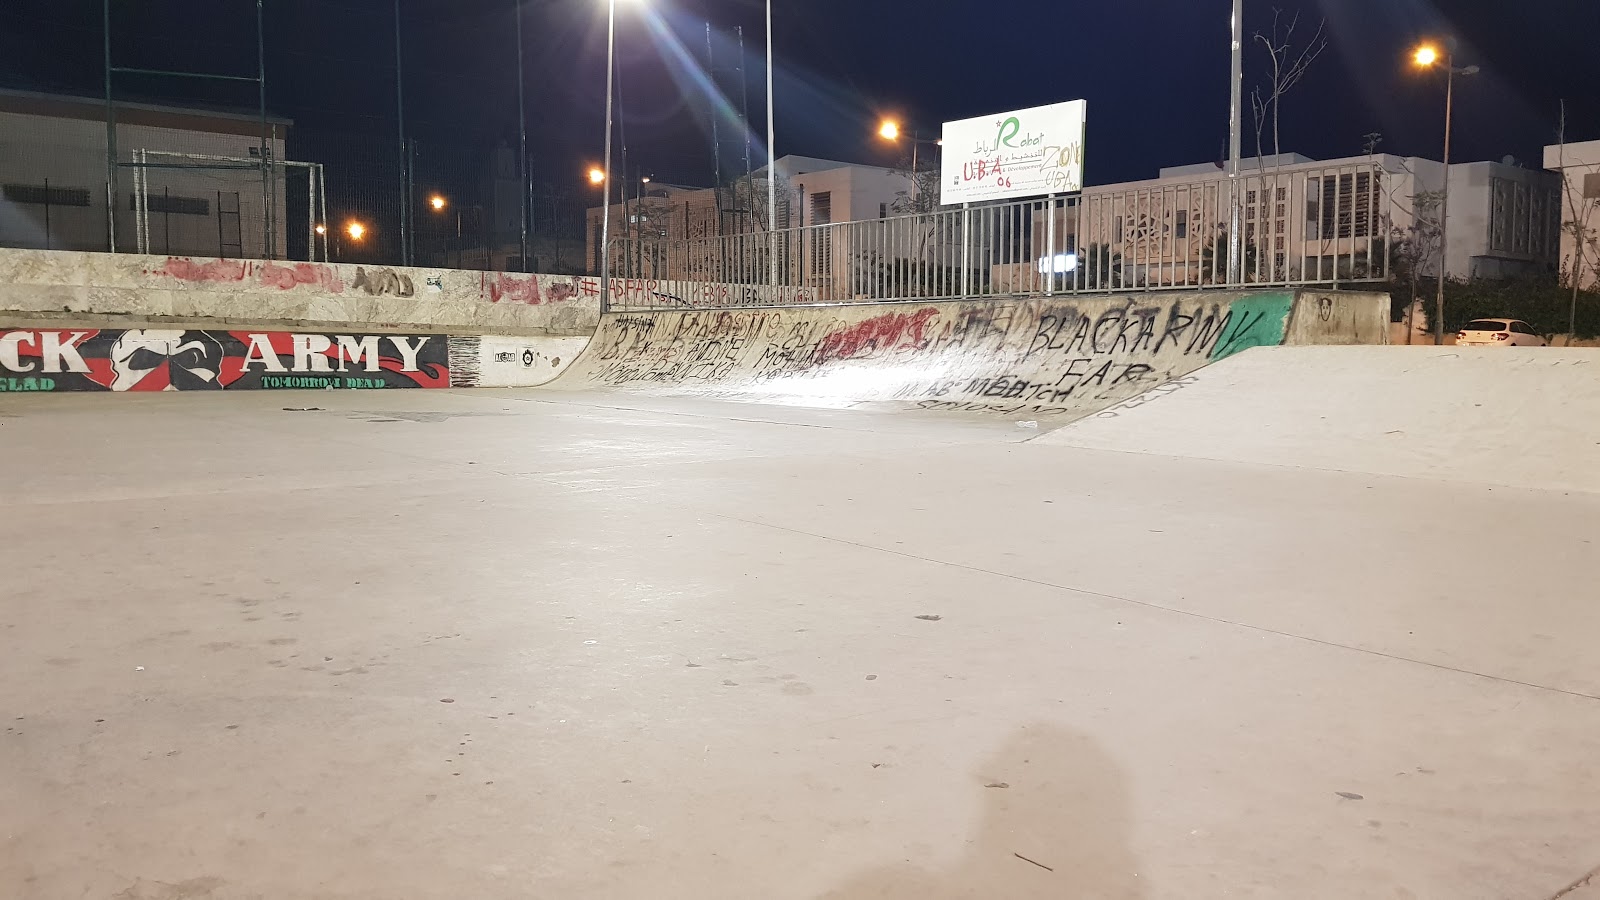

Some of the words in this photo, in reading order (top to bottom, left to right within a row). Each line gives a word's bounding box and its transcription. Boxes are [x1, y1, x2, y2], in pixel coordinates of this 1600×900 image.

[997, 116, 1045, 149] Rabat
[996, 176, 1013, 189] 06
[241, 333, 432, 374] ARMY
[261, 376, 341, 390] TOMORROW
[346, 377, 386, 390] DEAD
